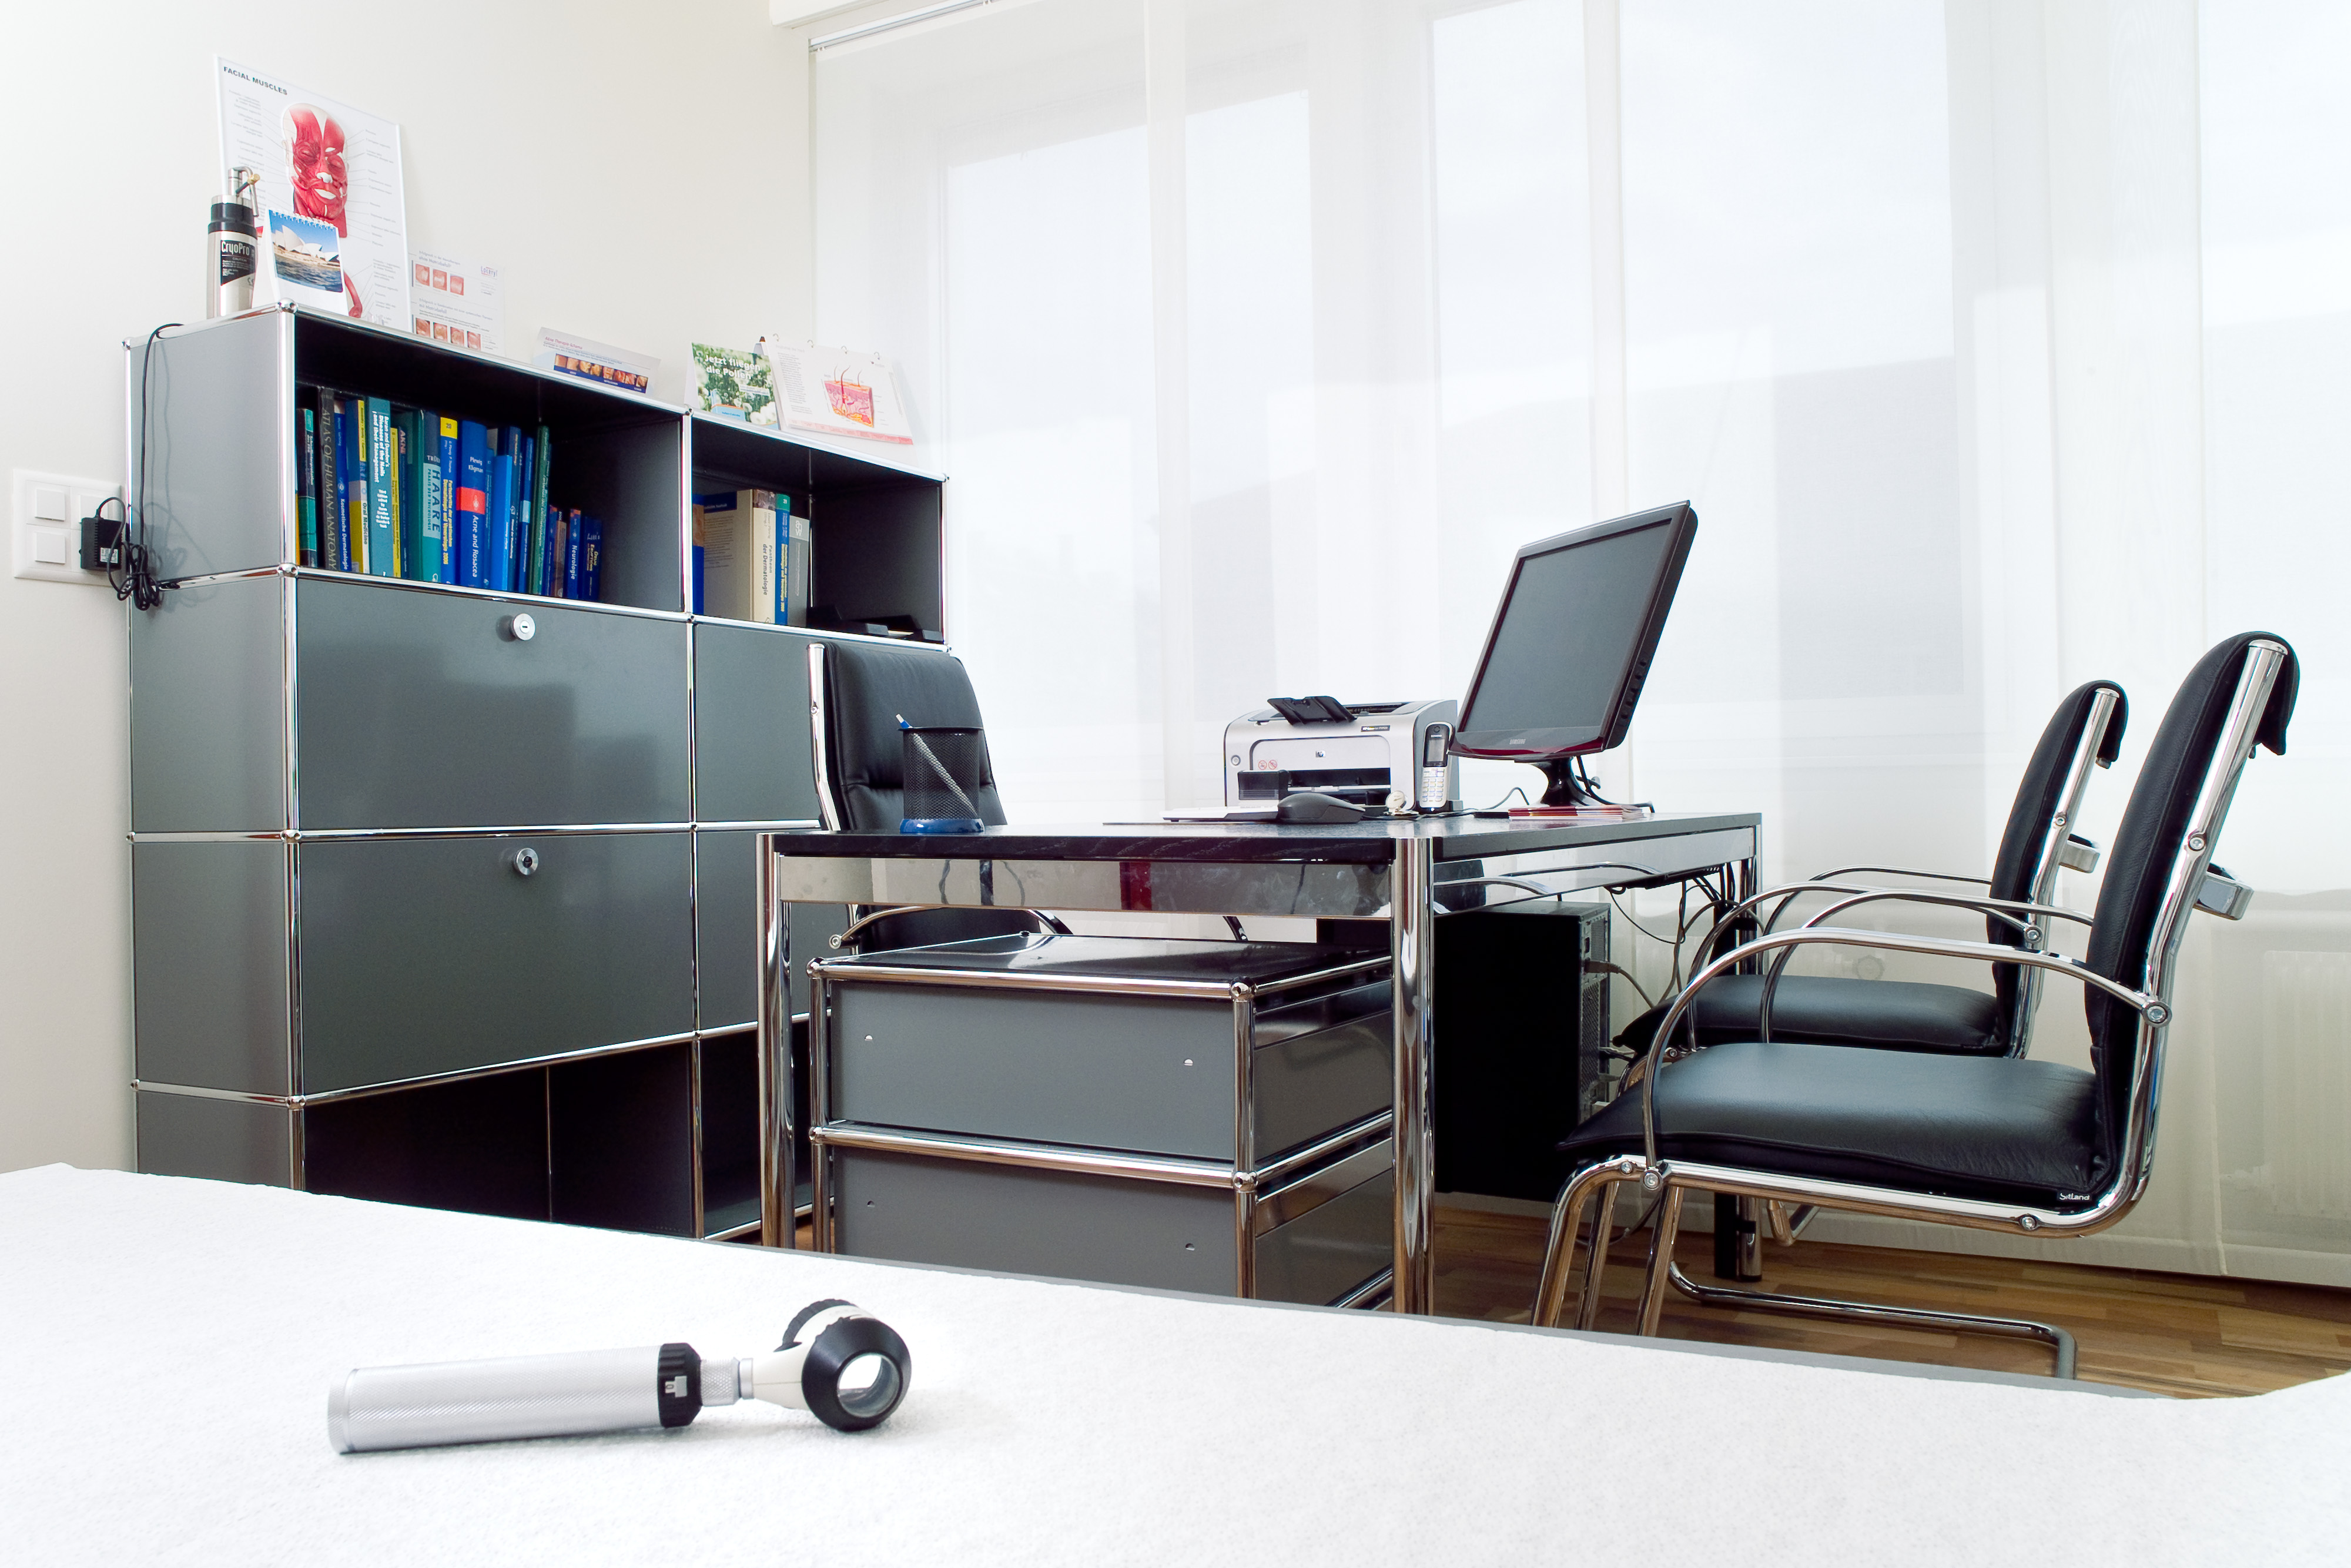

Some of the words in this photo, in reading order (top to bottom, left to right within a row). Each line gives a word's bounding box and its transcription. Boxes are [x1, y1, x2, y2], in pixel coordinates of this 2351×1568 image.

[224, 66, 250, 81] FACIAL
[252, 77, 287, 95] MUSCLES
[222, 241, 250, 256] CryoPro
[705, 355, 727, 365] Jetzt
[729, 358, 761, 371] fliegen
[706, 366, 720, 375] die
[723, 368, 751, 380] Pollen
[322, 407, 331, 443] ATLAS
[324, 445, 332, 461] OF
[324, 464, 334, 510] HUMAN
[432, 469, 440, 532] HAARE
[327, 514, 337, 570] ANATOMY
